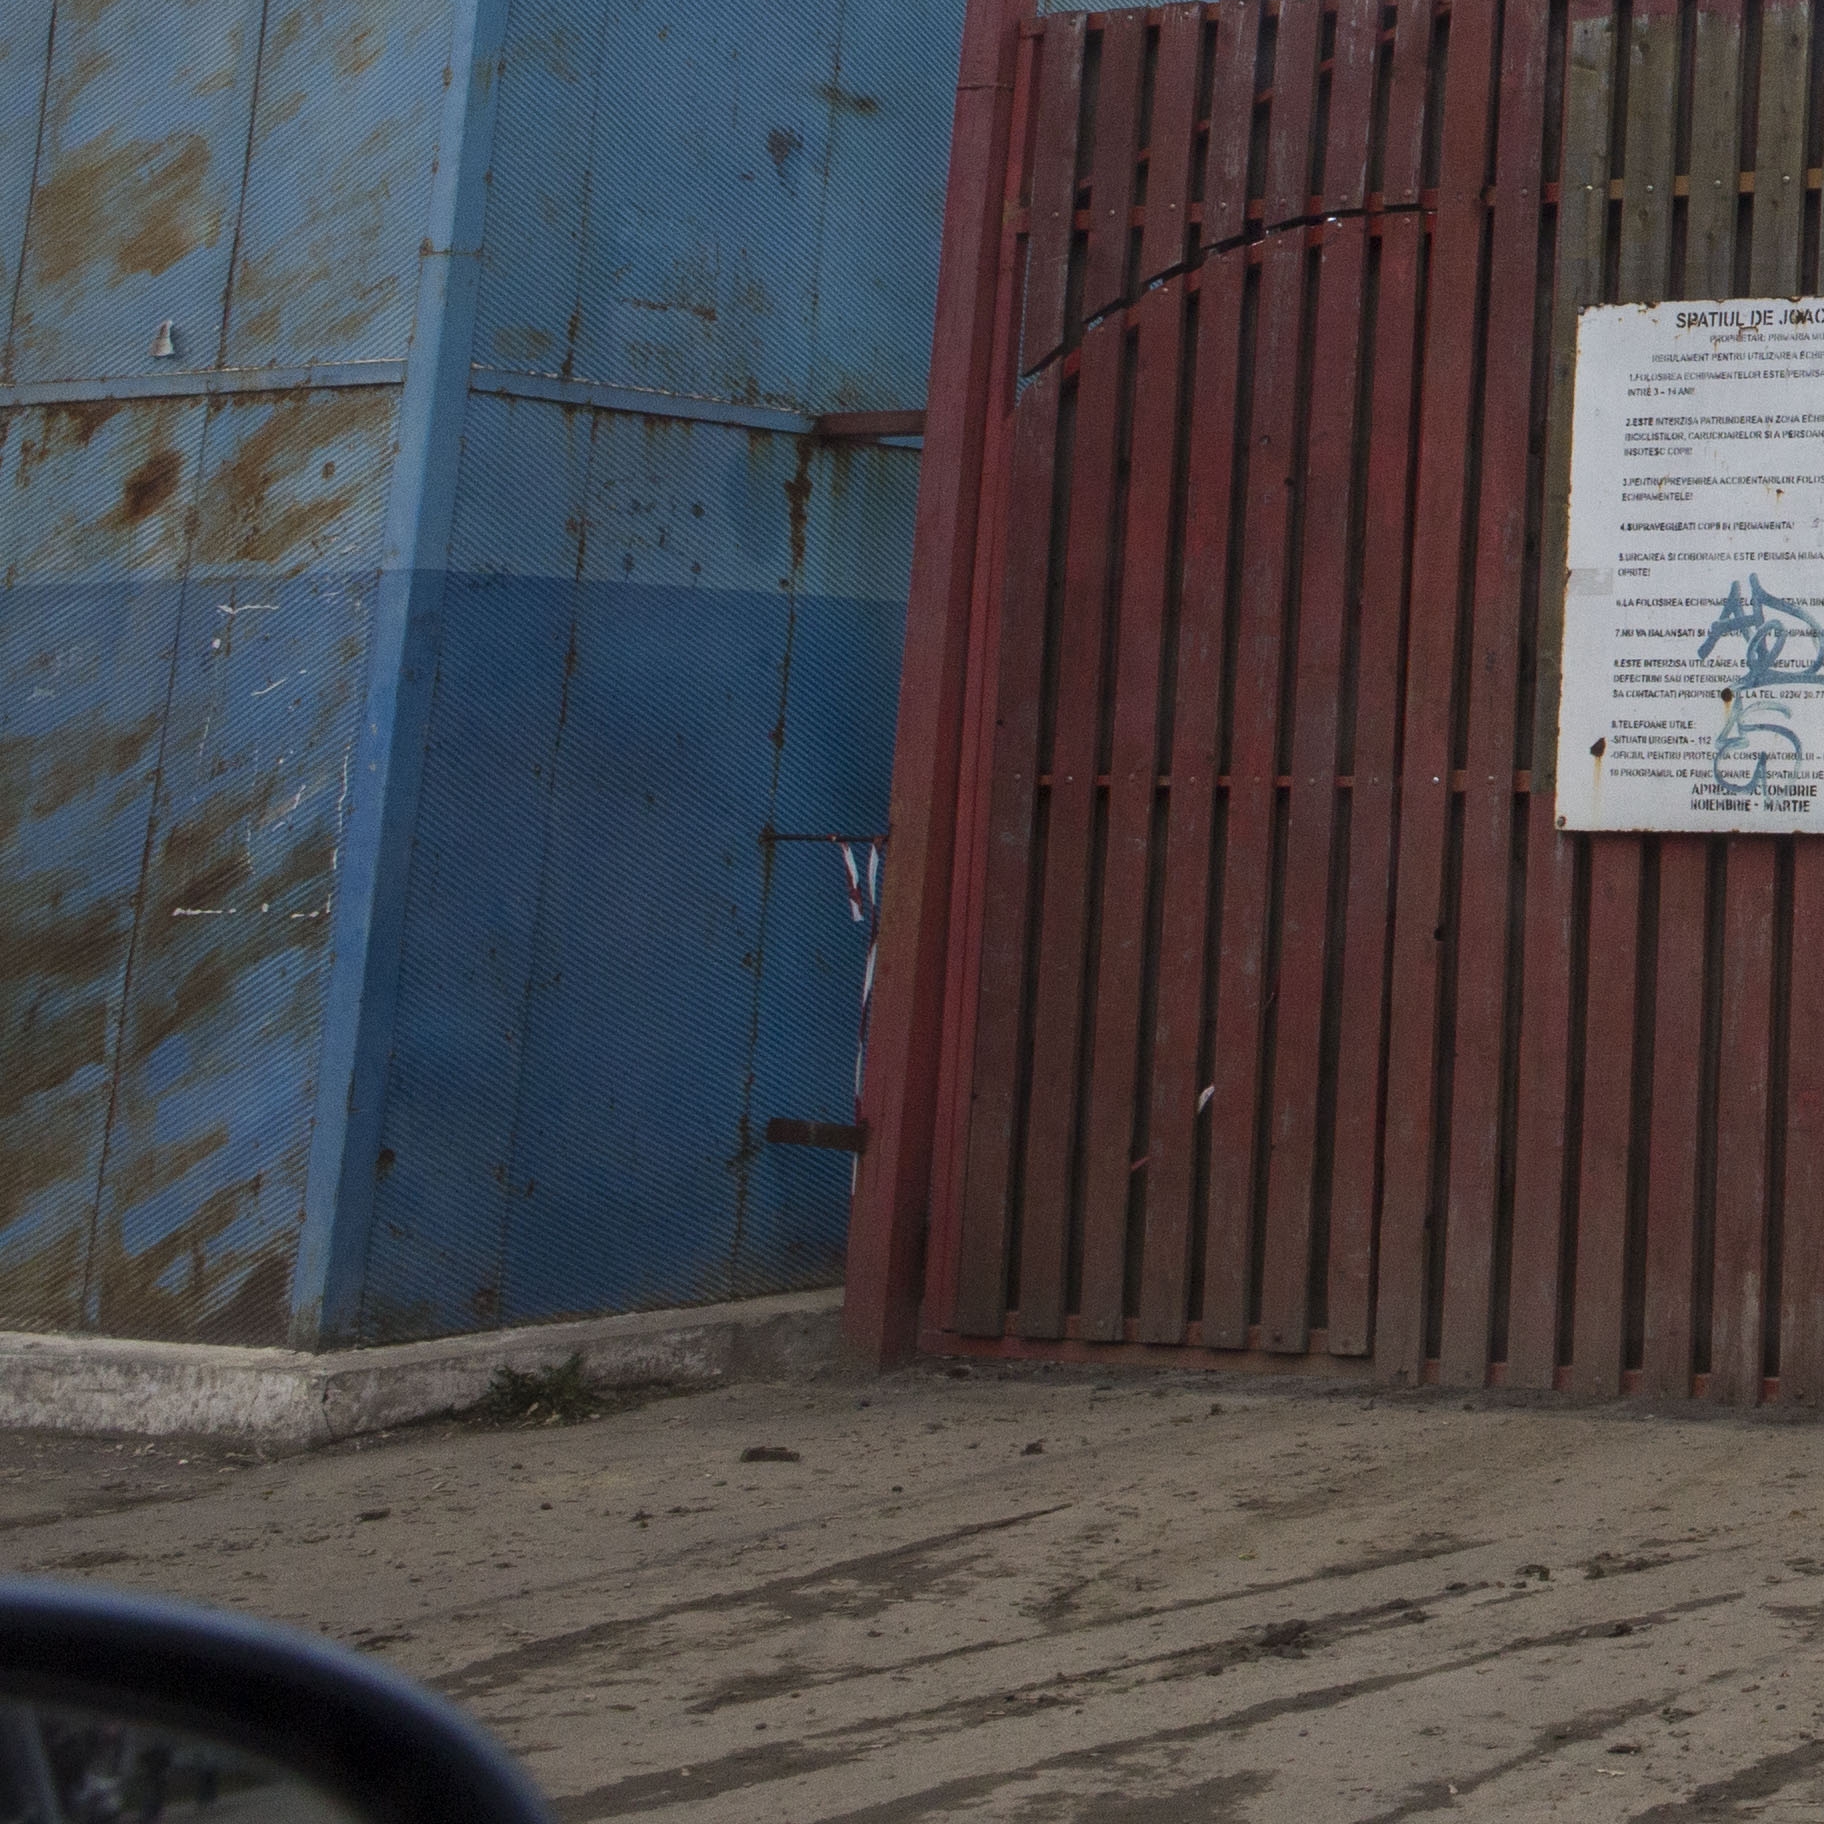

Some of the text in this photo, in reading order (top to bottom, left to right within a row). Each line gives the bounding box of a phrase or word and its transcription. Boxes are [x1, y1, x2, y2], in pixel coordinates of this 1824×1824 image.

[1676, 311, 1745, 329] SPATIUL
[1750, 309, 1774, 326] DE
[1763, 799, 1811, 813] MARTIE
